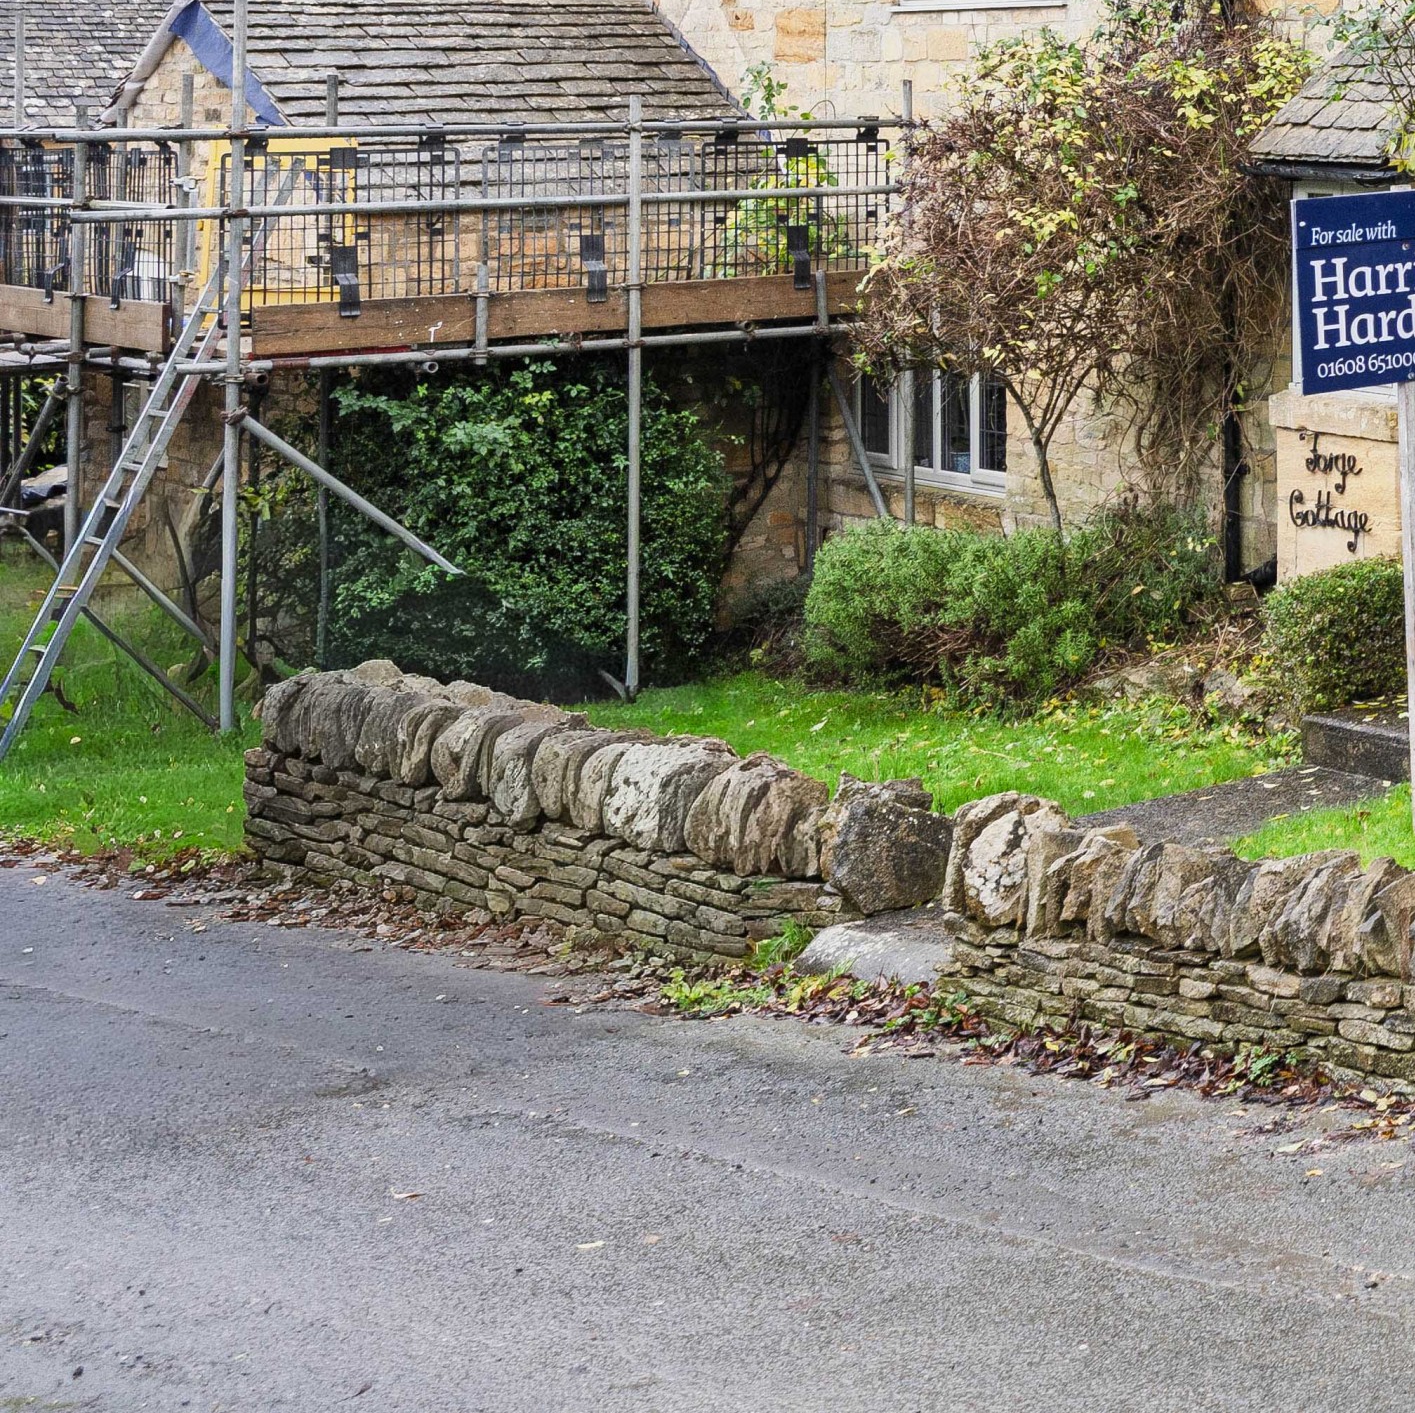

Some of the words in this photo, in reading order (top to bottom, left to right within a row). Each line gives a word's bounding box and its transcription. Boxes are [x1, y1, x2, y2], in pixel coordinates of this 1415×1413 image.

[1310, 226, 1334, 246] For
[1336, 223, 1364, 244] sale
[1366, 219, 1397, 240] with
[1317, 355, 1366, 379] 01608
[1289, 489, 1372, 553] Cottage
